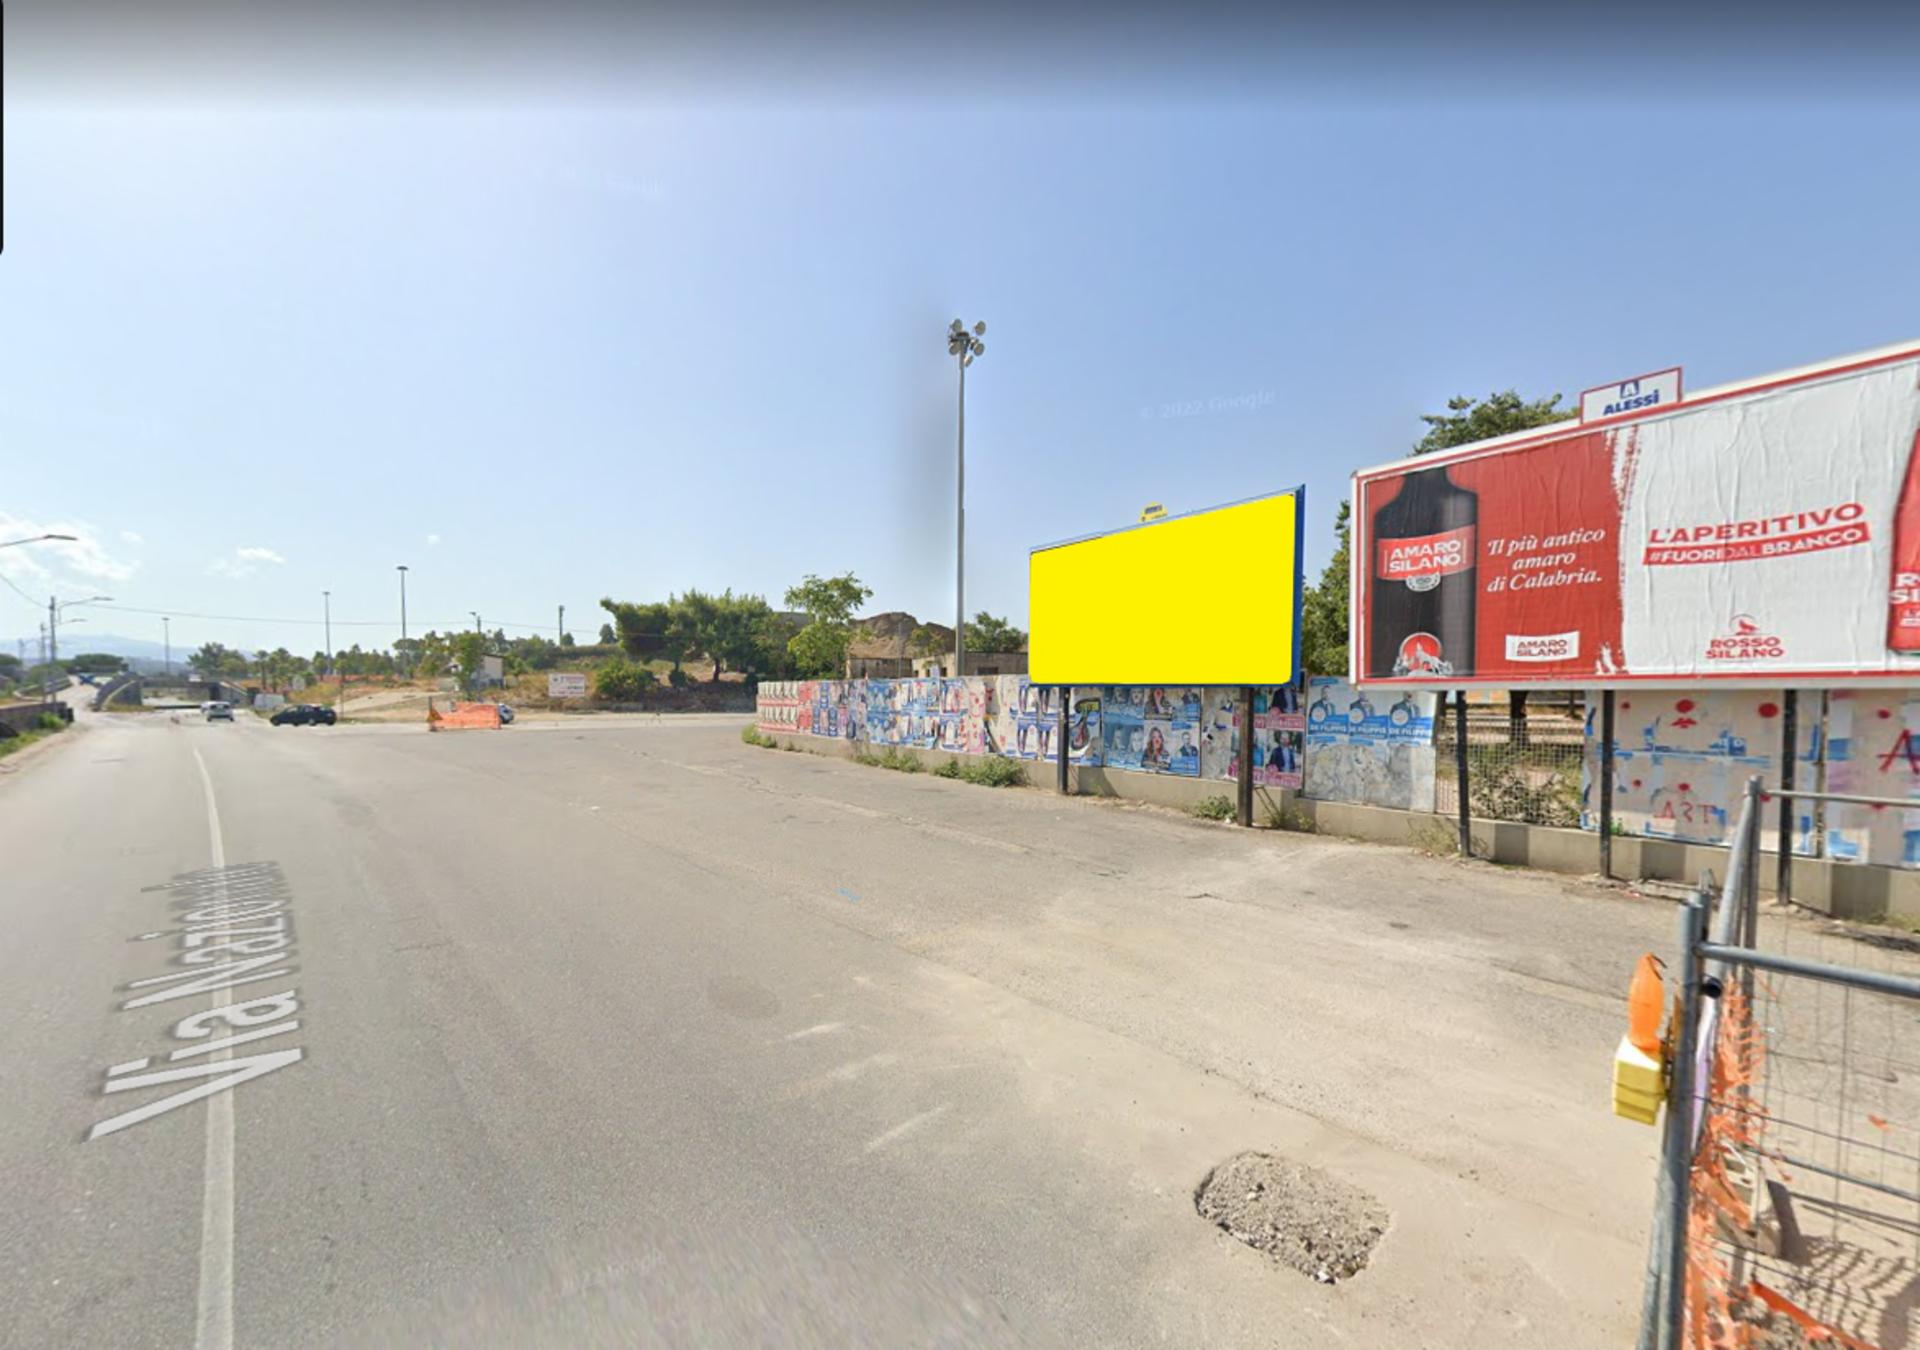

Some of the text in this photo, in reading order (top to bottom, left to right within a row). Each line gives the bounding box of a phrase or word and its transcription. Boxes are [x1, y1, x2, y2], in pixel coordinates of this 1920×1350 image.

[1650, 503, 1864, 543] L'APERITIVO
[1390, 540, 1461, 560] AMARO
[1487, 528, 1606, 557] Il più antico
[1389, 554, 1461, 573] SILANO
[1512, 553, 1576, 570] amaro
[1487, 568, 1603, 592] di Calabria.
[1517, 648, 1567, 657] SILANO
[1518, 639, 1567, 649] AMARO
[1710, 637, 1781, 650] ROSSO
[1706, 648, 1783, 659] SILANO
